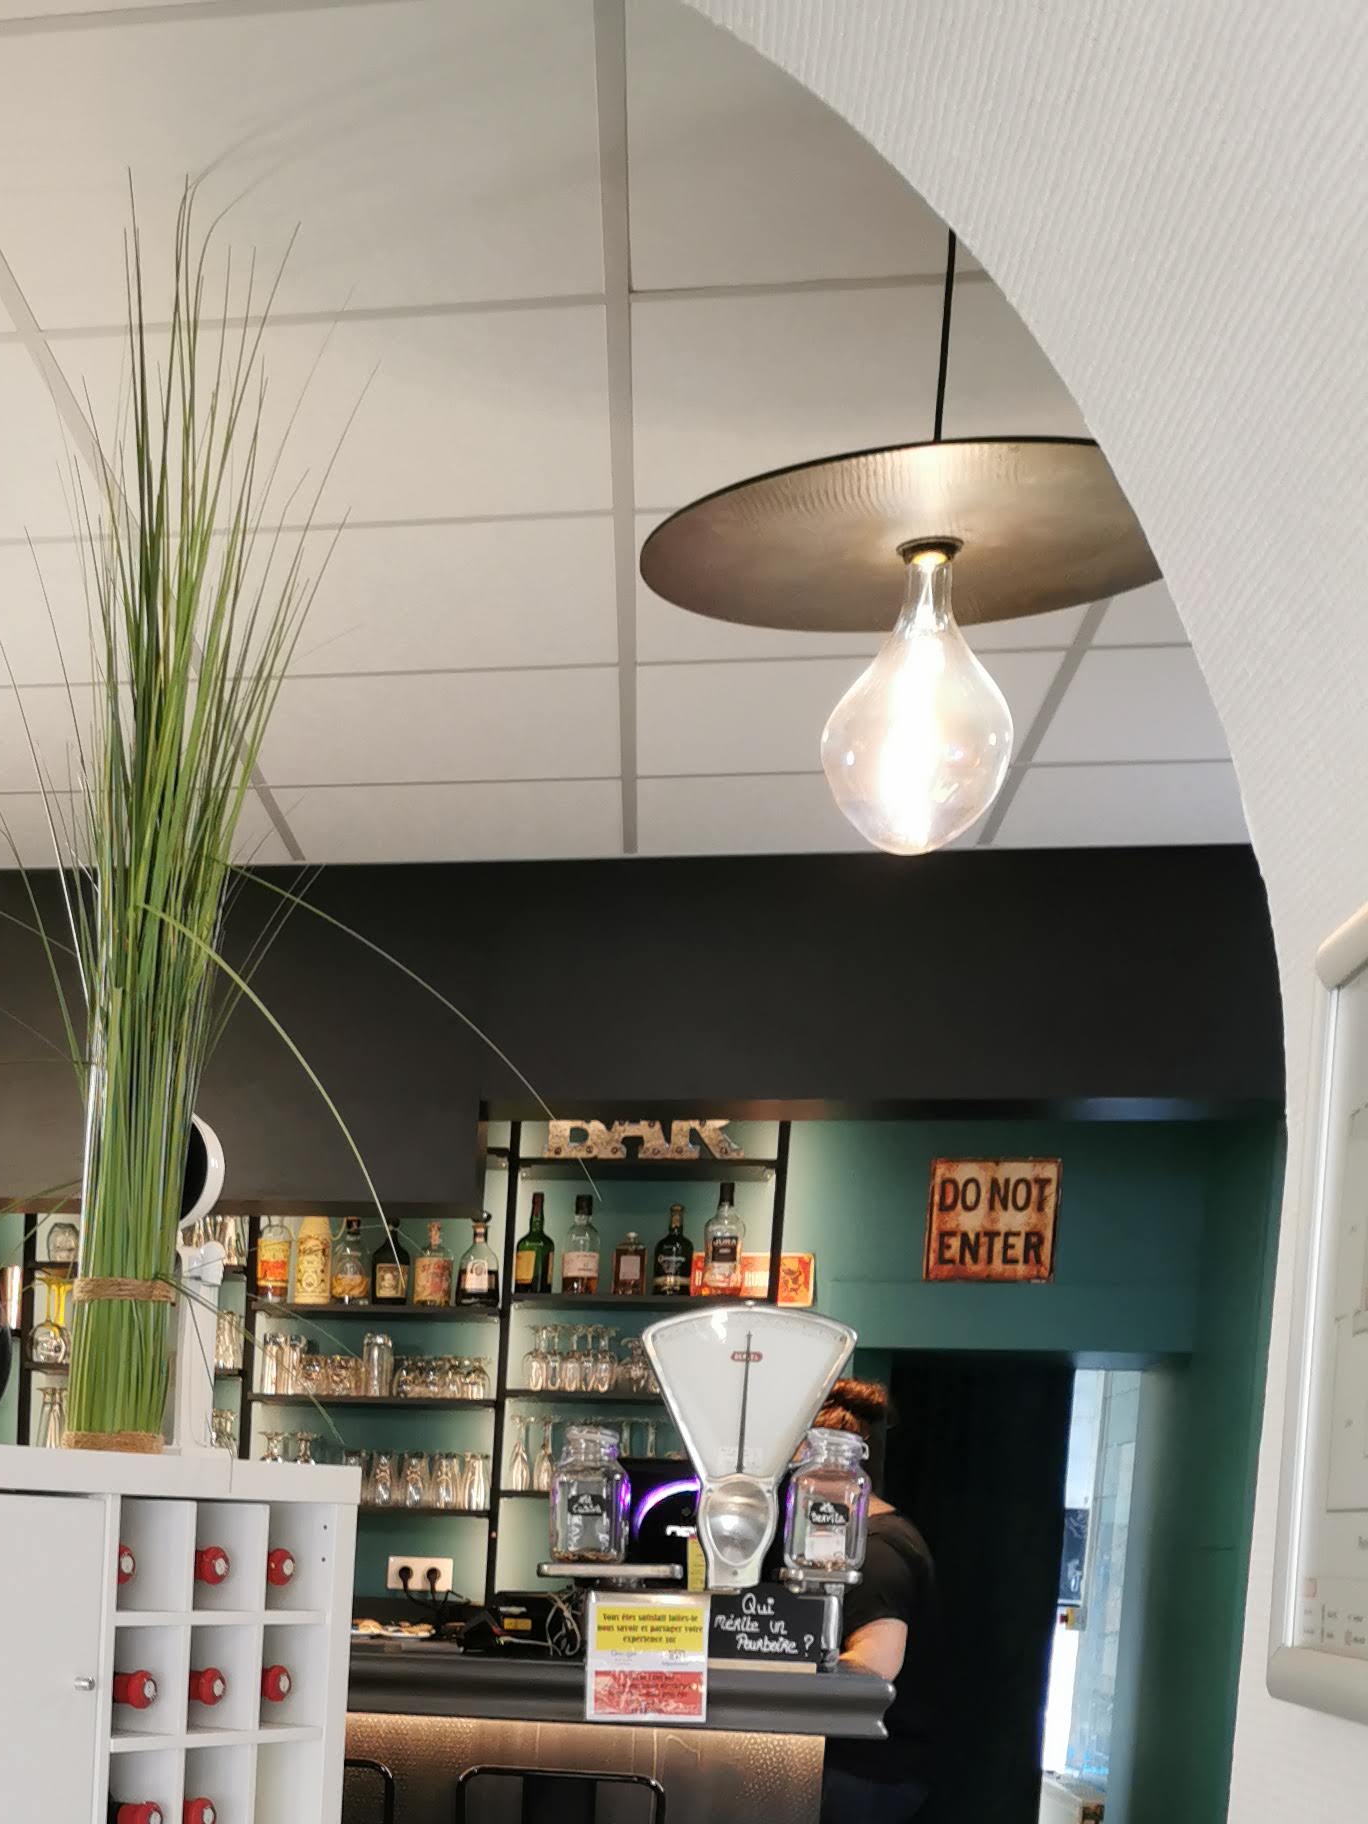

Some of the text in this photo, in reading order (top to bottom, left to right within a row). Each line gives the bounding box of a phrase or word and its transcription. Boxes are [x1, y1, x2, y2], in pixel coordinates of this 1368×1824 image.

[543, 1120, 744, 1159] BAR
[939, 1177, 1052, 1212] DO NOT
[938, 1231, 1044, 1265] ENTER
[742, 1592, 775, 1615] Qui
[769, 1620, 788, 1635] un
